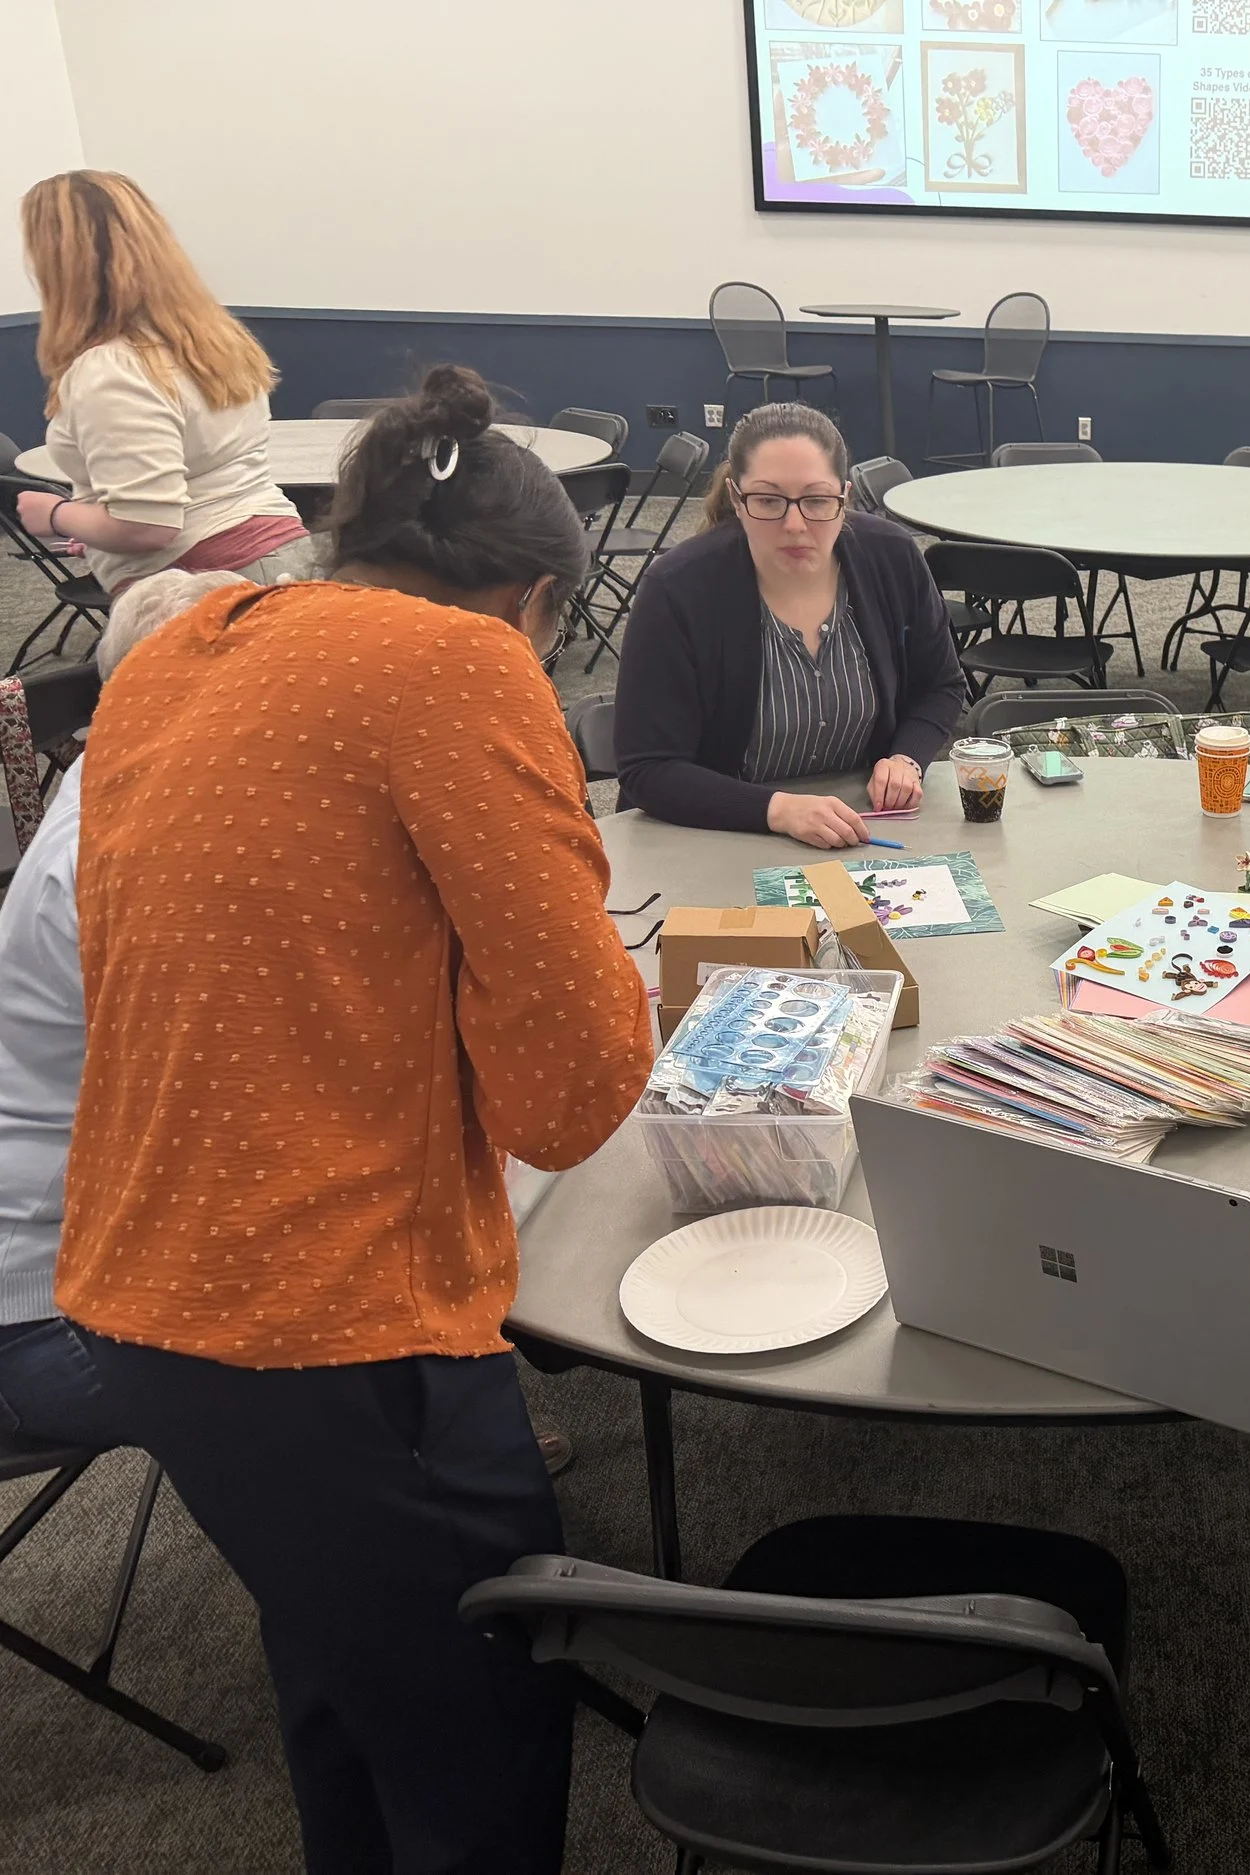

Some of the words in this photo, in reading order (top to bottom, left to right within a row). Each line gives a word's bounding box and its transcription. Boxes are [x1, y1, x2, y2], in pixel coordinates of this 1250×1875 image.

[1200, 67, 1213, 77] 35
[1215, 67, 1245, 80] Types
[1192, 81, 1230, 93] Shapes
